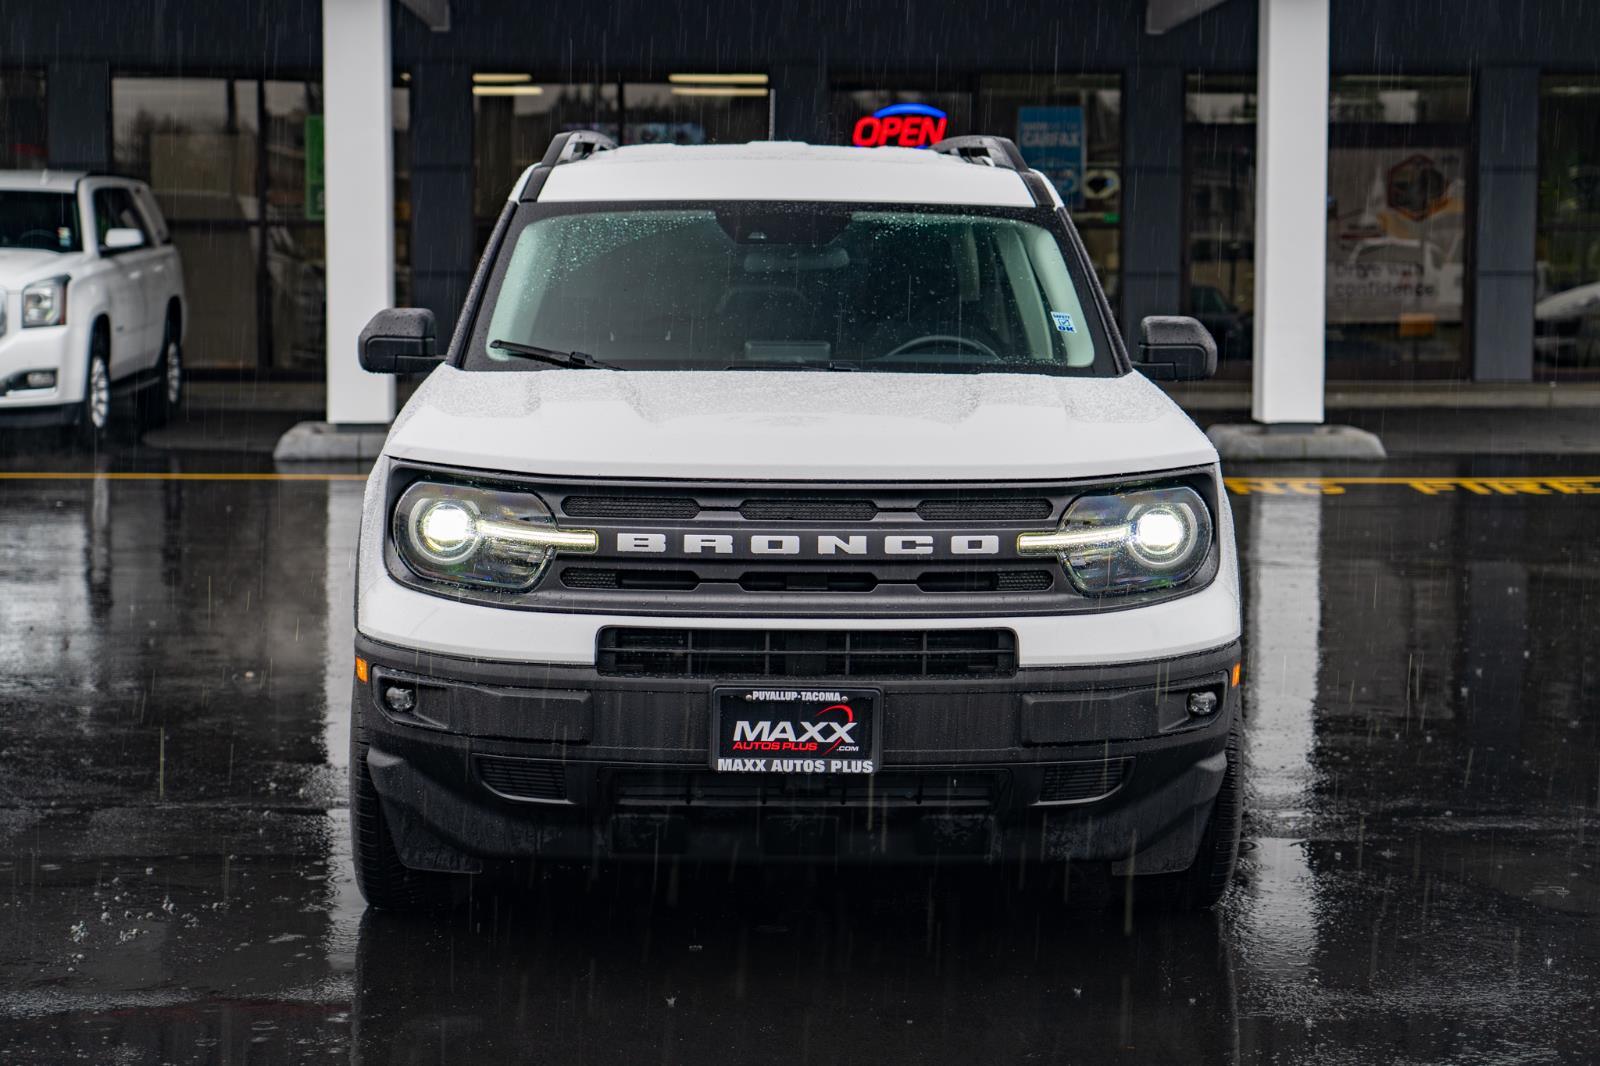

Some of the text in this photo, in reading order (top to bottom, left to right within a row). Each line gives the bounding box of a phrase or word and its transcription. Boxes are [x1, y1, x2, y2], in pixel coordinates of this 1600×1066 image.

[852, 115, 948, 147] OPEN
[616, 532, 1000, 555] BRONCO
[732, 720, 858, 744] MAXX
[732, 741, 779, 751] AUTOS
[781, 742, 818, 751] PLUS
[717, 758, 874, 774] MAXX AUTOS PLUS
